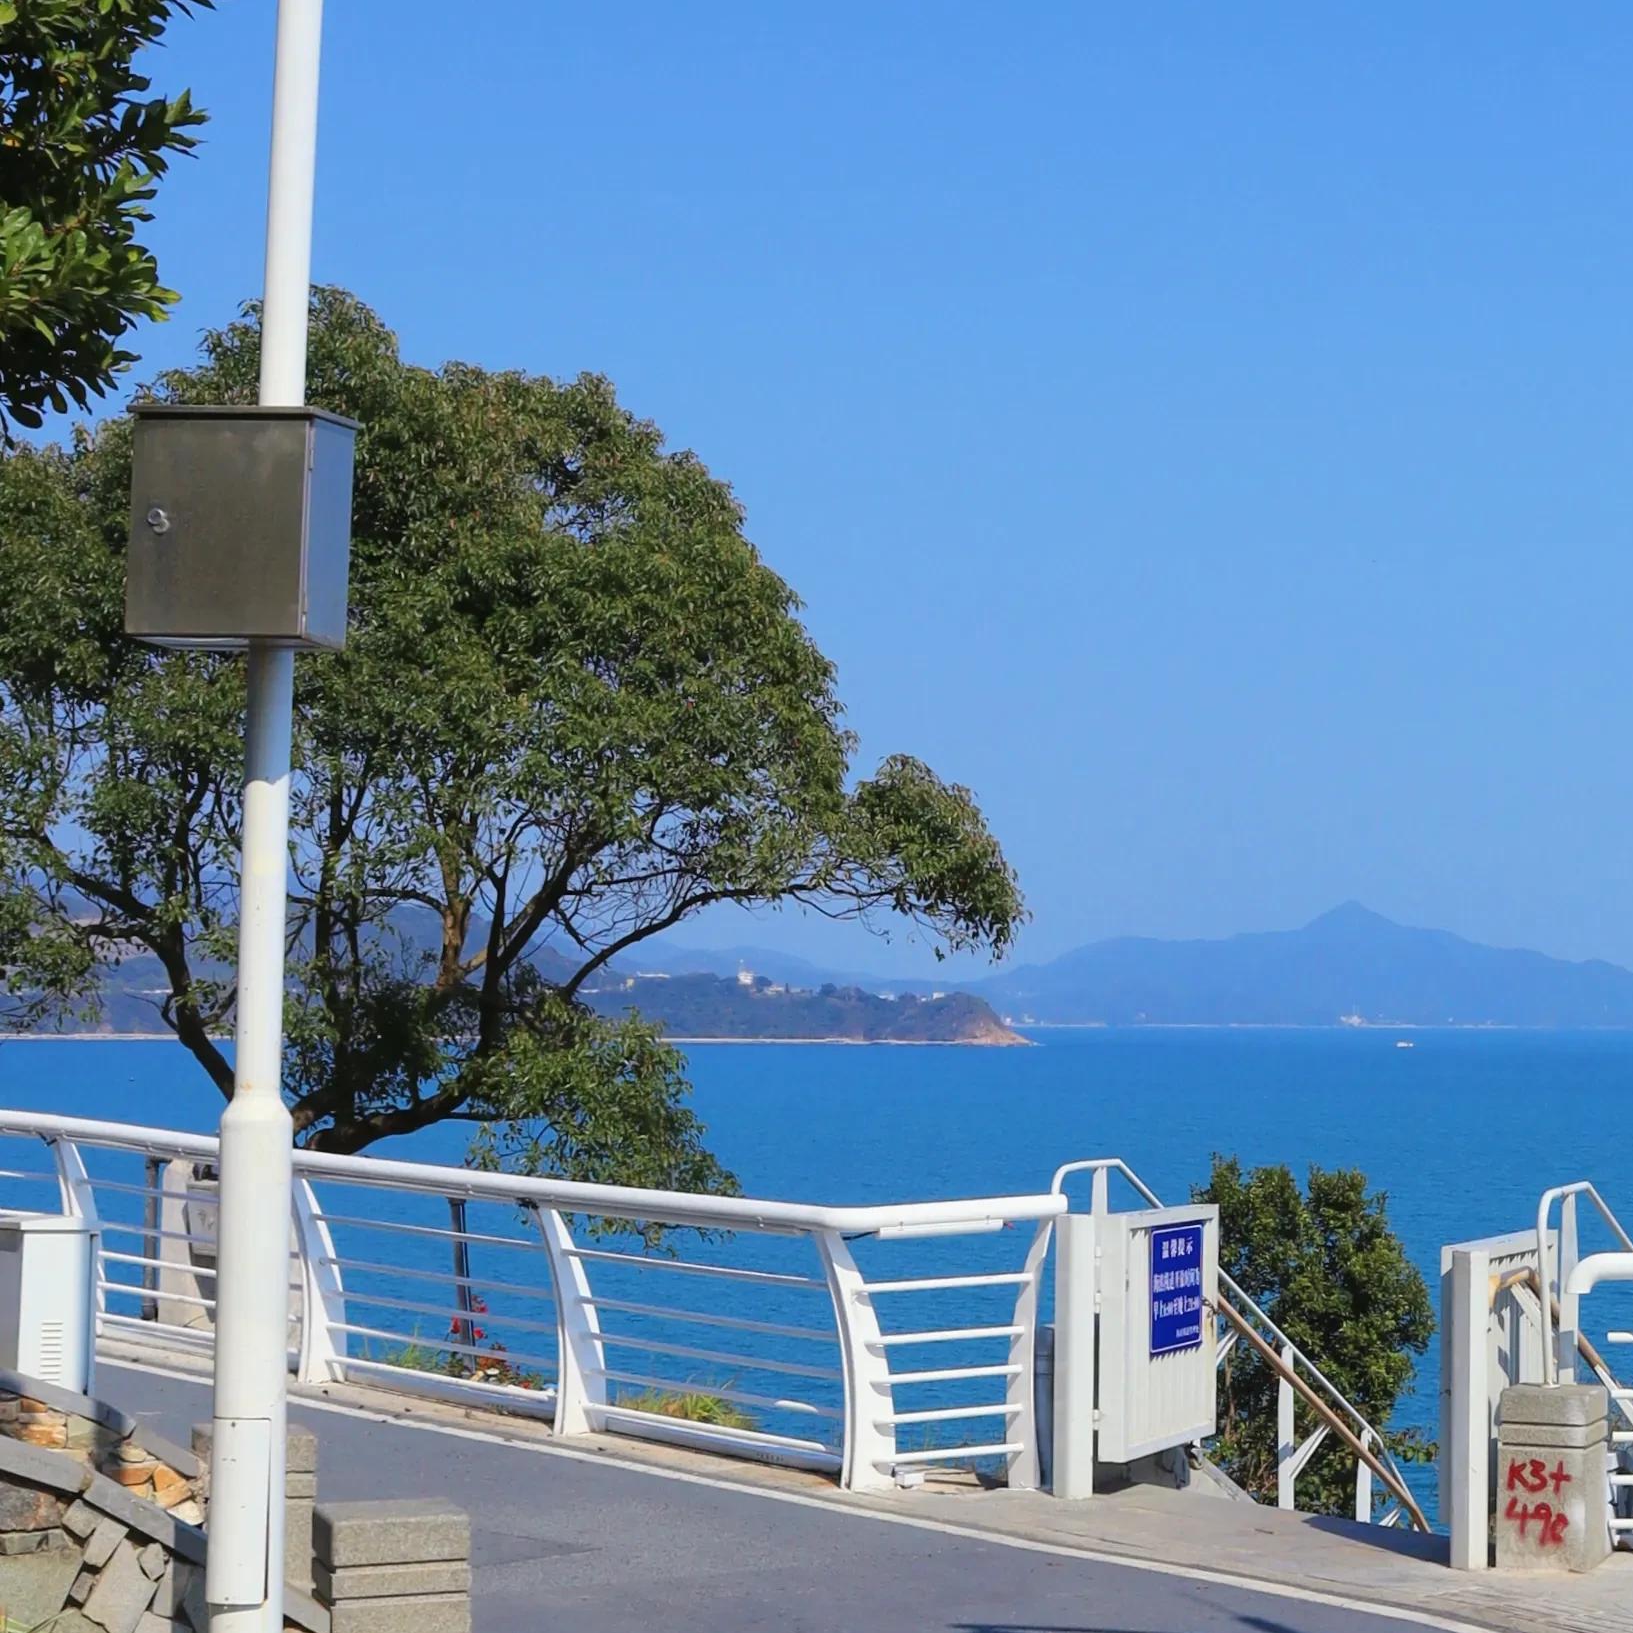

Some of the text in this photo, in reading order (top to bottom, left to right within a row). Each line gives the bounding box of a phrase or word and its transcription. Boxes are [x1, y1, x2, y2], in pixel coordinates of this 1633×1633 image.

[1162, 1236, 1194, 1259] 温馨提示
[1506, 1458, 1572, 1495] K3+
